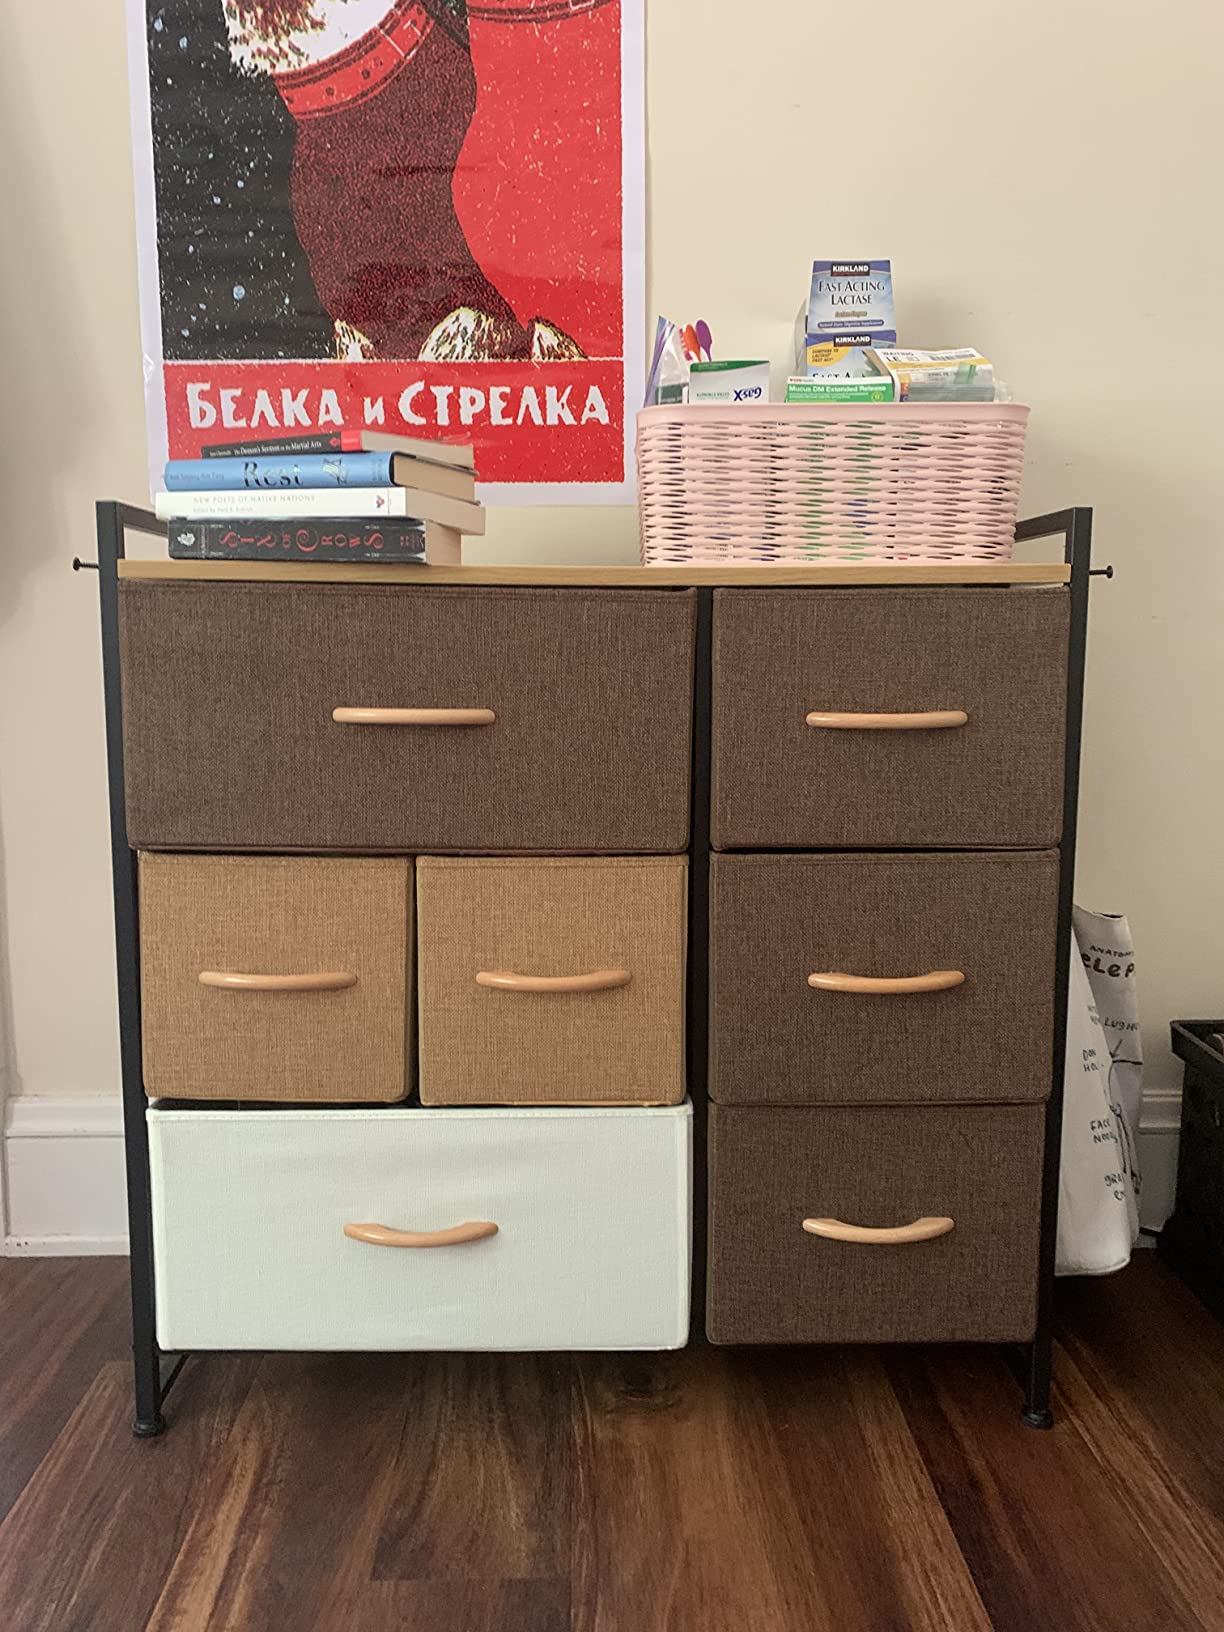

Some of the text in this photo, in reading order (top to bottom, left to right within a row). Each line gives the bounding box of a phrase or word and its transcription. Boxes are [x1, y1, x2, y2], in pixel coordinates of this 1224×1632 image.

[832, 265, 870, 273] KIRKLAND
[819, 280, 885, 292] FAST ACTING
[831, 294, 873, 306] LACTASE
[835, 335, 871, 344] KIRKLAND
[789, 385, 812, 393] Mucus
[813, 385, 825, 393] DM
[186, 381, 345, 429] БЕЛКА
[398, 380, 611, 427] СТРЕЛКА
[240, 446, 261, 455] Demon's
[291, 440, 310, 450] Martial
[310, 440, 323, 449] Arts
[243, 460, 304, 488] Rest
[193, 494, 316, 505] NEW POETS OF NATIVE NATIONS
[295, 528, 384, 552] CROWS
[1089, 945, 1135, 958] ANATOM
